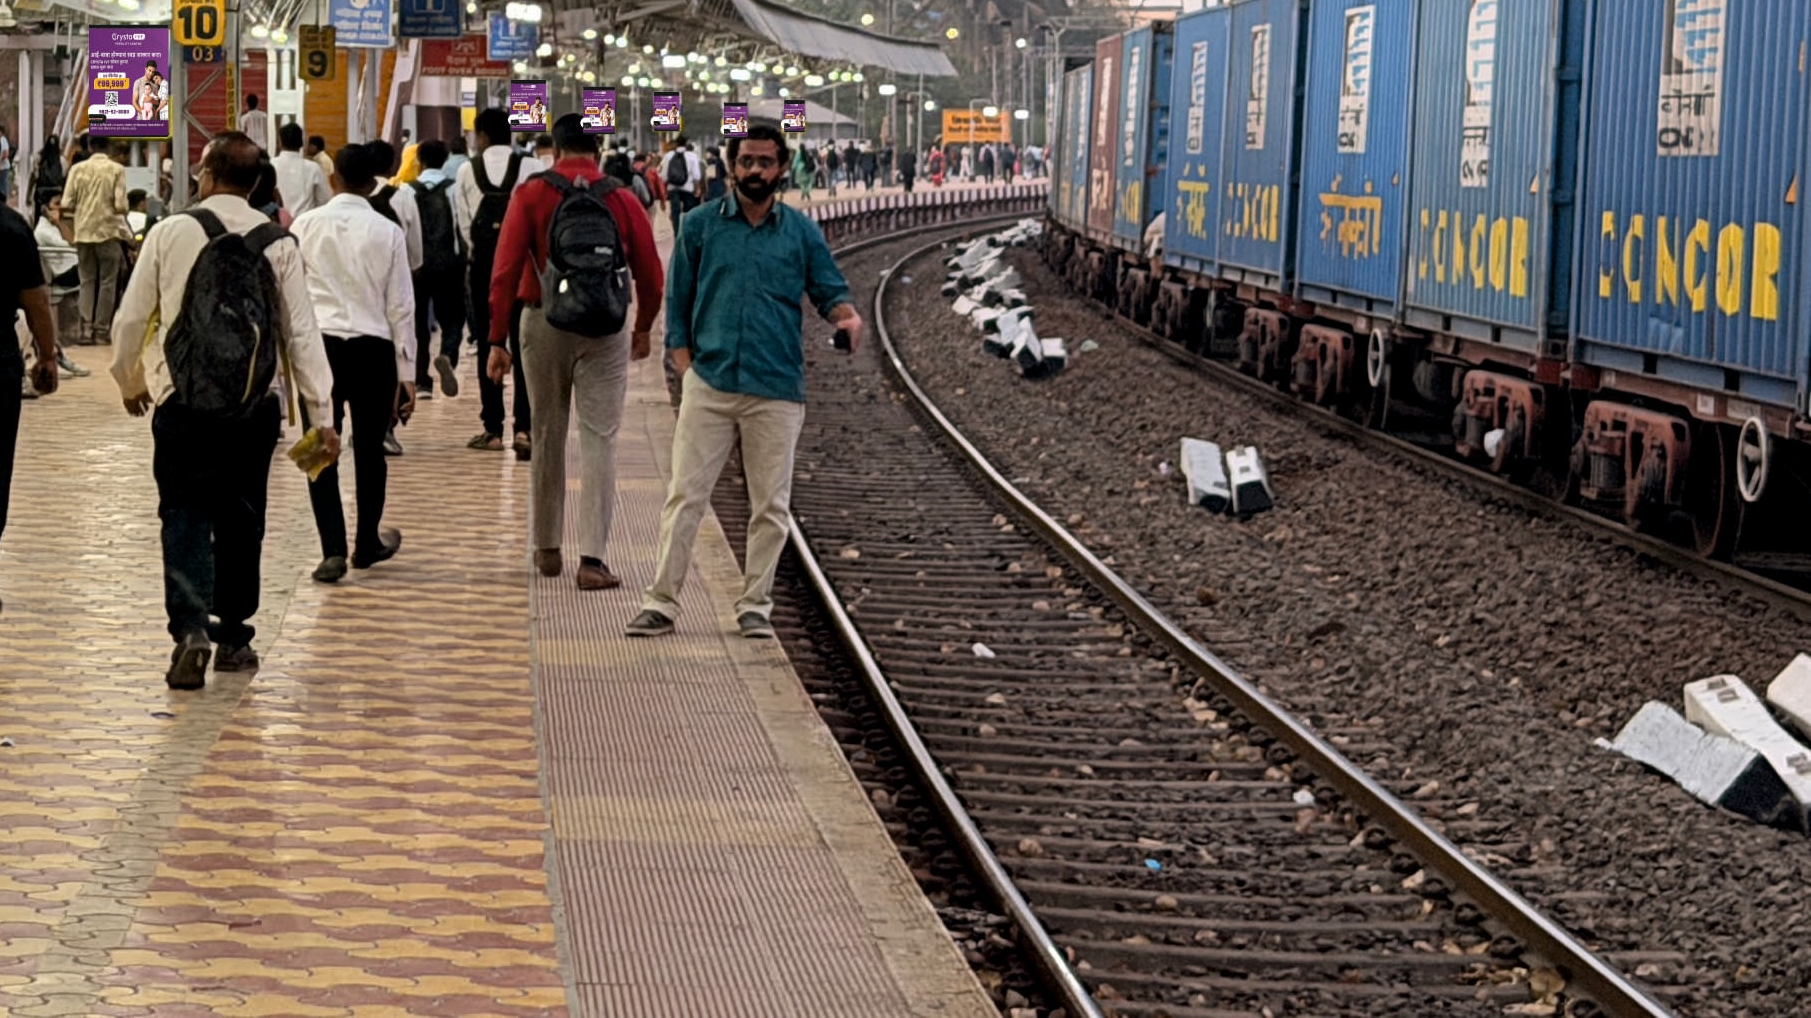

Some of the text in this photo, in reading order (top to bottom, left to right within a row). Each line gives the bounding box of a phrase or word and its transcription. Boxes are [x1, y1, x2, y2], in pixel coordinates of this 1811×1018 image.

[178, 5, 218, 40] 10
[192, 46, 214, 62] 03
[307, 50, 328, 77] 9
